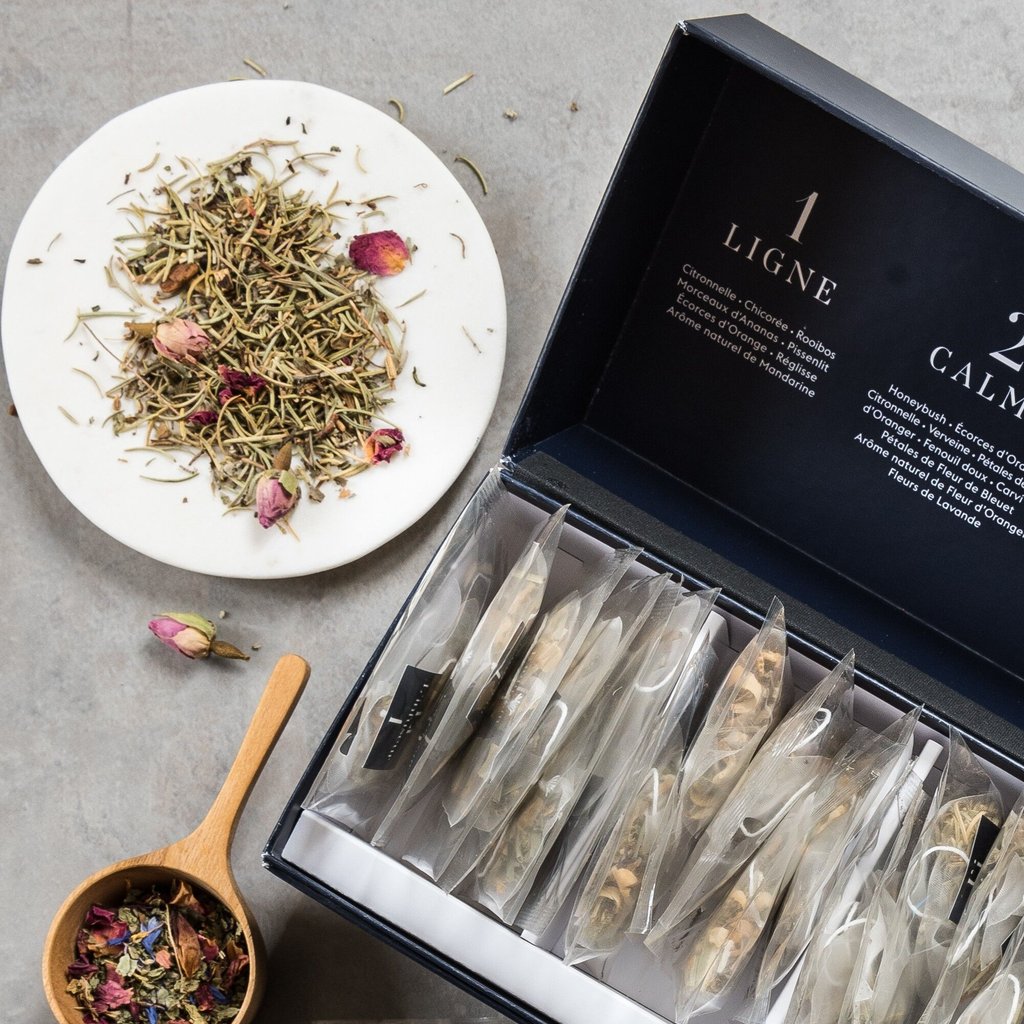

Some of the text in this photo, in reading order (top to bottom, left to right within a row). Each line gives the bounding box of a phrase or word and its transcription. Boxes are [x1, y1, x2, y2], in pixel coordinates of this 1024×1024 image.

[787, 191, 819, 244] 1
[722, 223, 838, 306] LIGNE
[666, 306, 815, 398] Arôme naturel de Mandarine
[676, 293, 817, 382] Écorces d'Orange Réglisse
[677, 277, 829, 373] Morceaux d'Ananas Pissenlit
[683, 263, 836, 360] Citronnelle Chicorée Rooibos
[862, 405, 916, 439] d'Oranger
[923, 438, 961, 466] Fenouil
[961, 463, 988, 482] doux
[996, 481, 1024, 503] Carvi
[867, 389, 920, 426] Citronnelle
[929, 423, 970, 455] Verveine
[977, 453, 1013, 480] Pétales
[888, 384, 946, 424] Honeybush
[954, 422, 994, 453] Écorces
[854, 433, 889, 458] Arôme
[891, 455, 930, 481] naturel
[930, 478, 945, 490] de
[946, 485, 973, 506] Fleur
[880, 430, 1015, 515] Pétales de Fleur de Bleuet
[887, 467, 981, 528] Fleurs de Lavande
